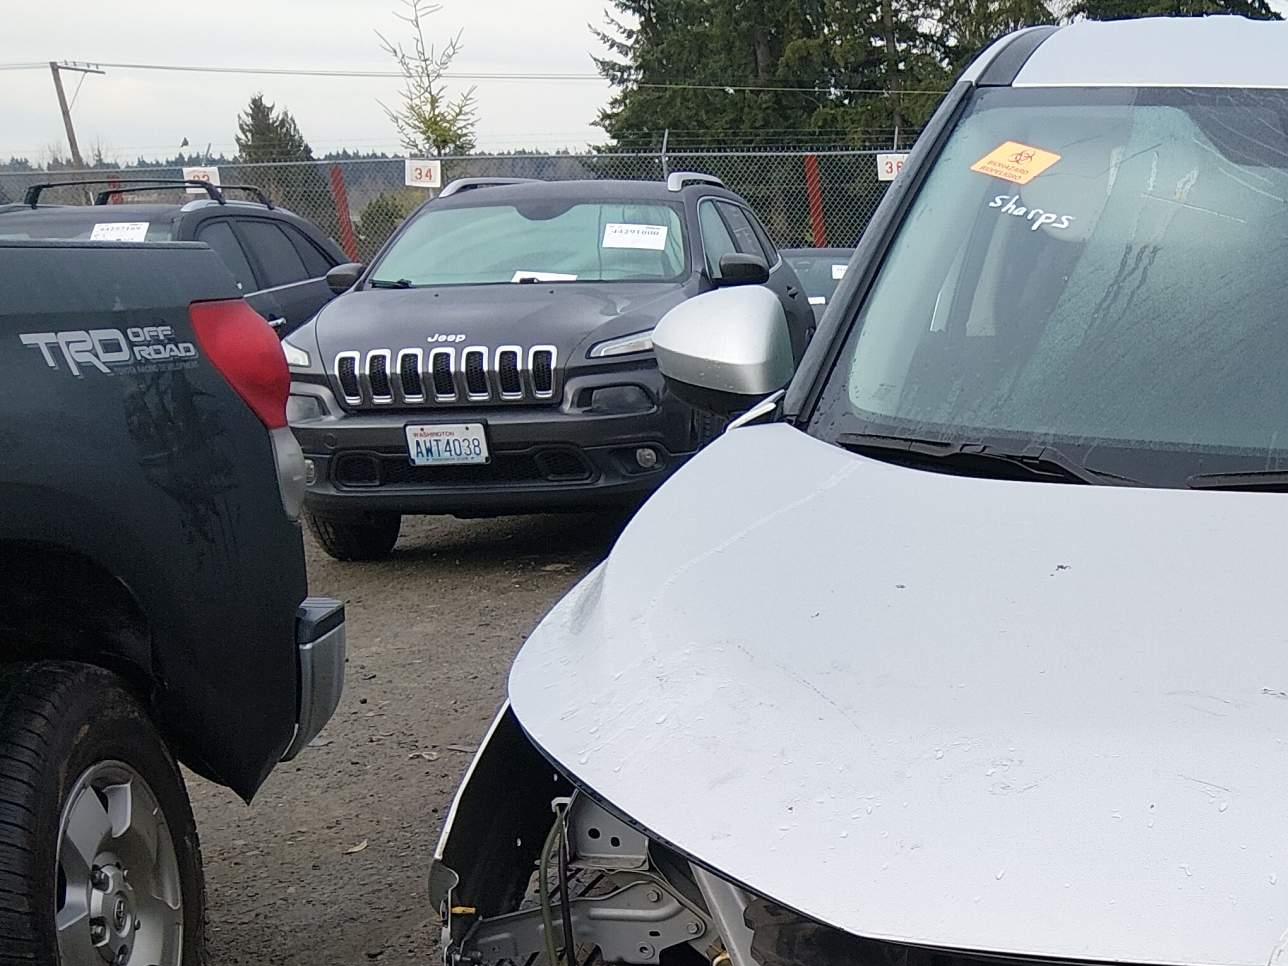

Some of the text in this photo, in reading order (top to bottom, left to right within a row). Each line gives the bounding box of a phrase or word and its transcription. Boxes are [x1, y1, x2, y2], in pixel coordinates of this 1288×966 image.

[415, 167, 432, 180] 34
[127, 326, 172, 342] OFF
[427, 334, 466, 343] Jeep
[19, 329, 131, 376] TRD
[133, 343, 197, 361] ROAD
[415, 438, 482, 458] AWT4038
